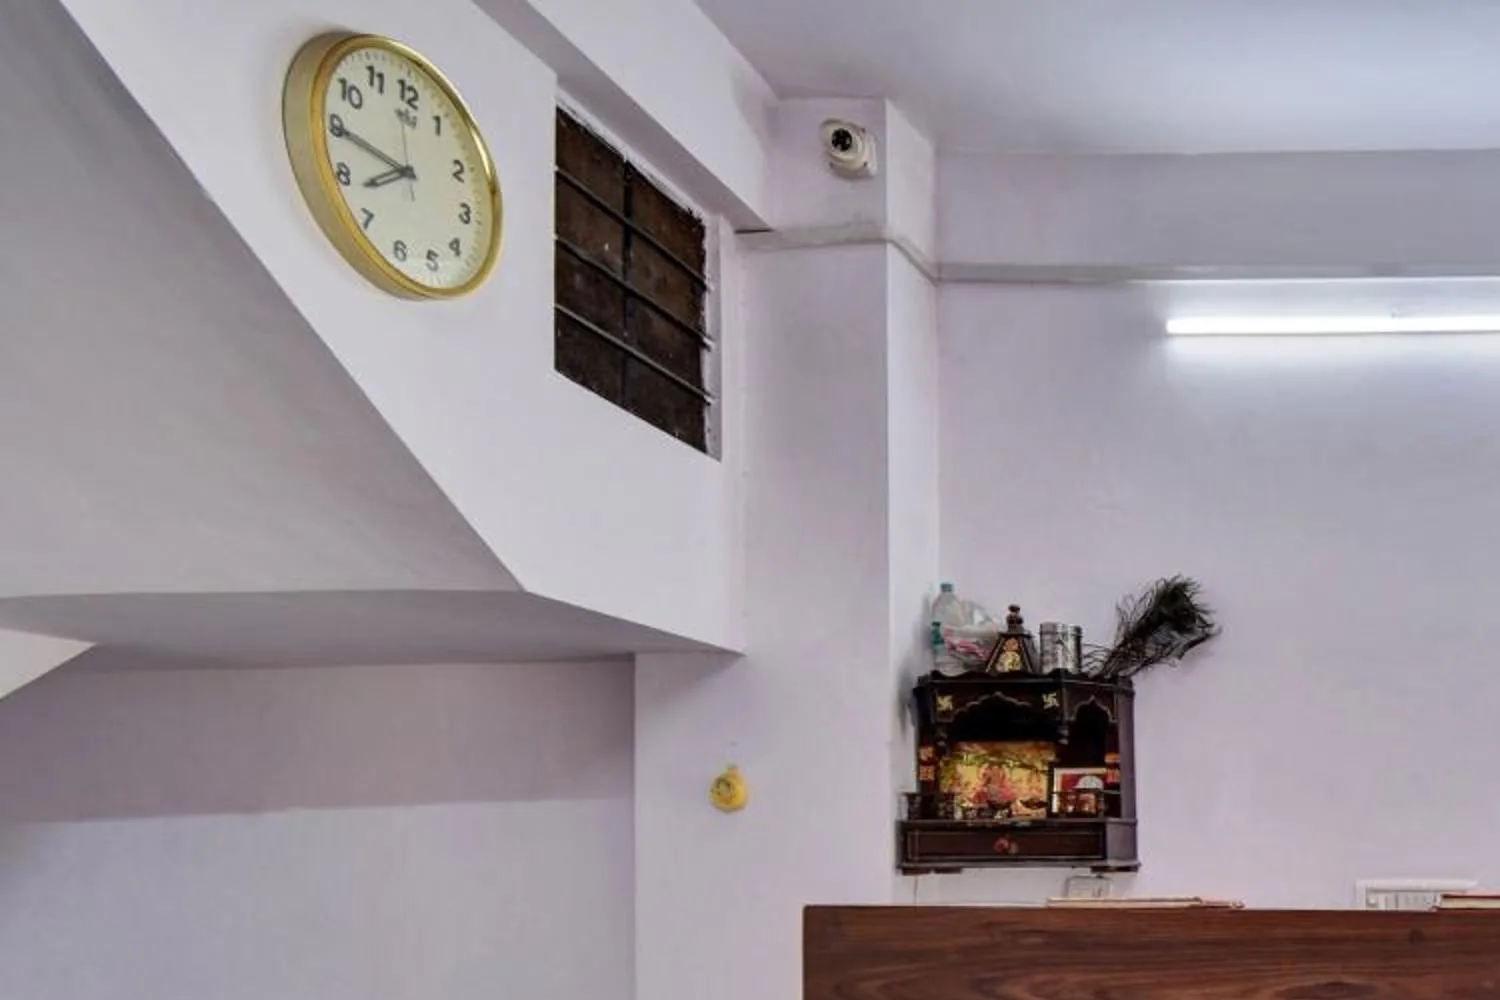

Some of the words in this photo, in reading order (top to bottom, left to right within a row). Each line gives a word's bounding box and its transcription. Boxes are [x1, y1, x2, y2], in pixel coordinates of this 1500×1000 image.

[366, 65, 385, 95] 11
[338, 78, 363, 109] 10
[397, 79, 419, 110] 12
[329, 114, 345, 138] 9
[432, 115, 441, 136] 1
[336, 162, 351, 186] 8
[452, 159, 465, 183] 2
[361, 208, 374, 230] 7
[459, 203, 471, 225] 3
[393, 240, 407, 262] 6
[448, 238, 460, 257] 4
[426, 250, 439, 272] 5
